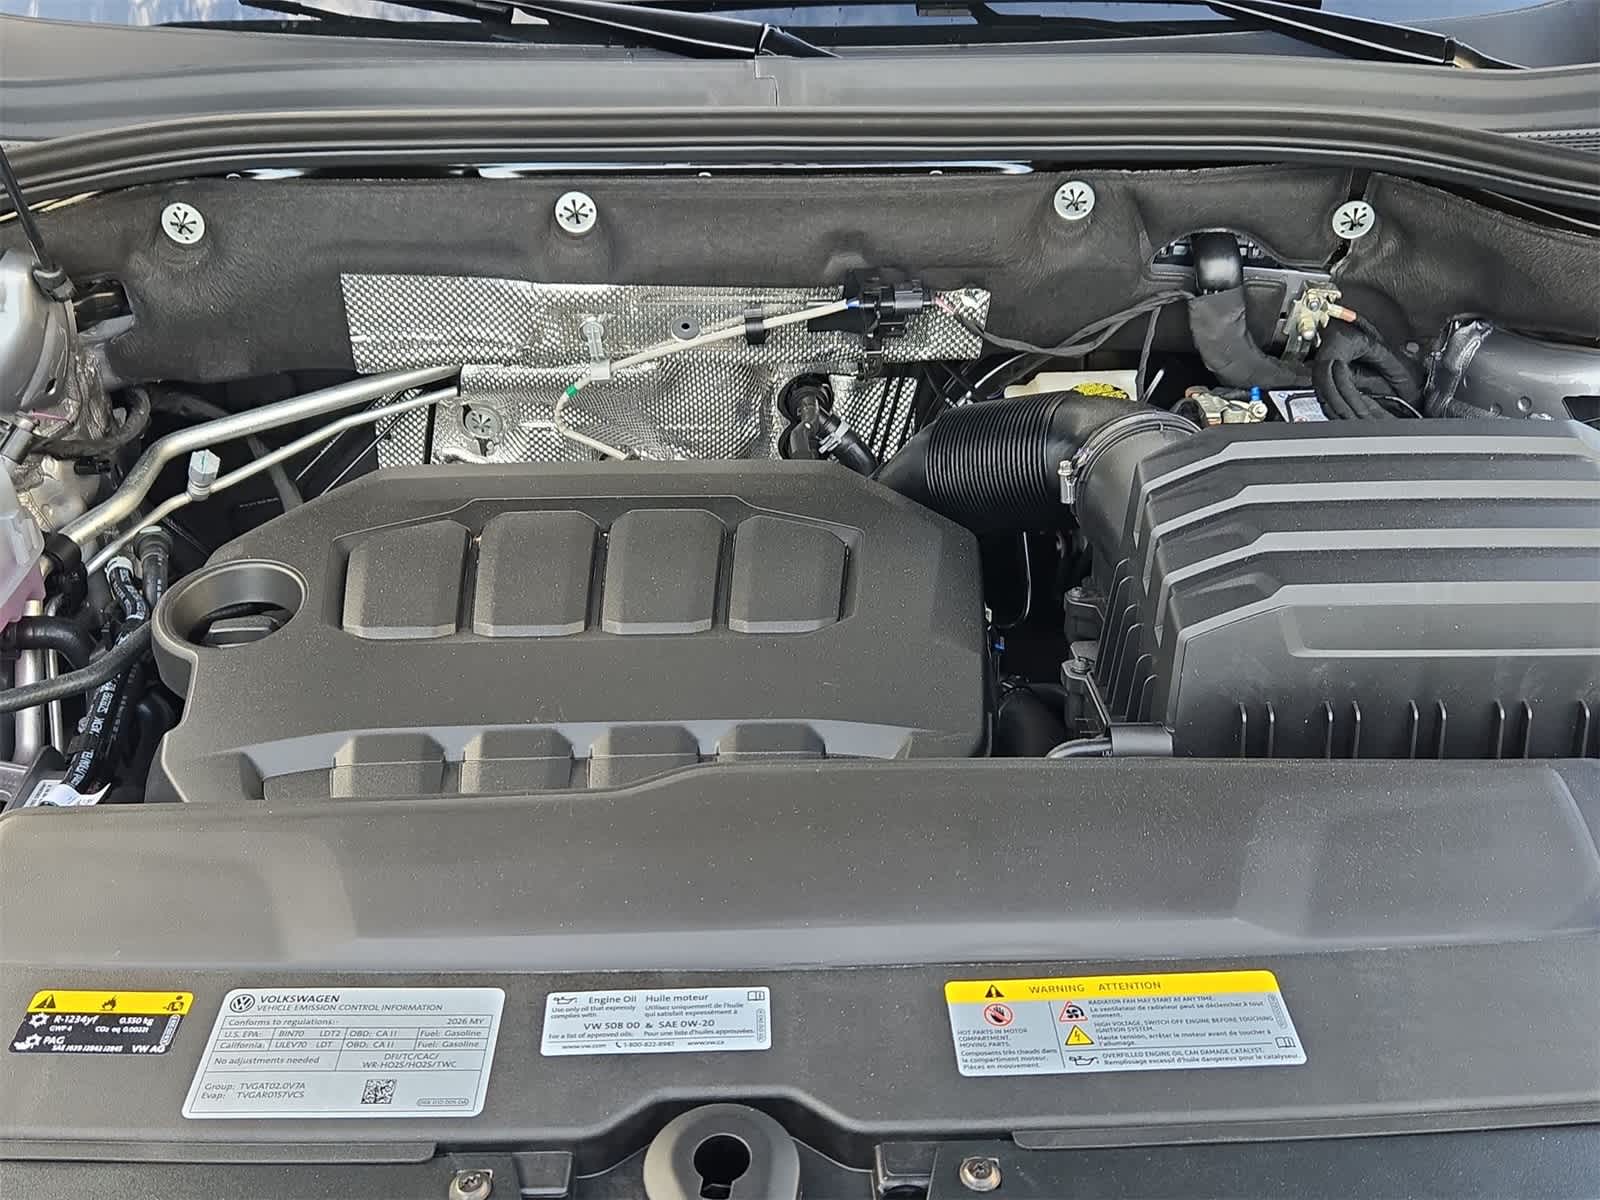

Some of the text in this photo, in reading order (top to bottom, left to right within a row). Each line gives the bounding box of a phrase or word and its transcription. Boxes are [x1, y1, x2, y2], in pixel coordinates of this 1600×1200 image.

[1028, 982, 1161, 993] WARNING ATTENTION
[260, 995, 340, 1003] VOLKSWAGEN
[589, 996, 622, 1004] Engine
[54, 1015, 99, 1025] R-1234yf
[141, 1017, 154, 1026] kg
[282, 1018, 336, 1027] regulations:
[43, 1036, 65, 1045] PAG
[230, 1057, 284, 1066] adjustments
[204, 1083, 235, 1091] Group:
